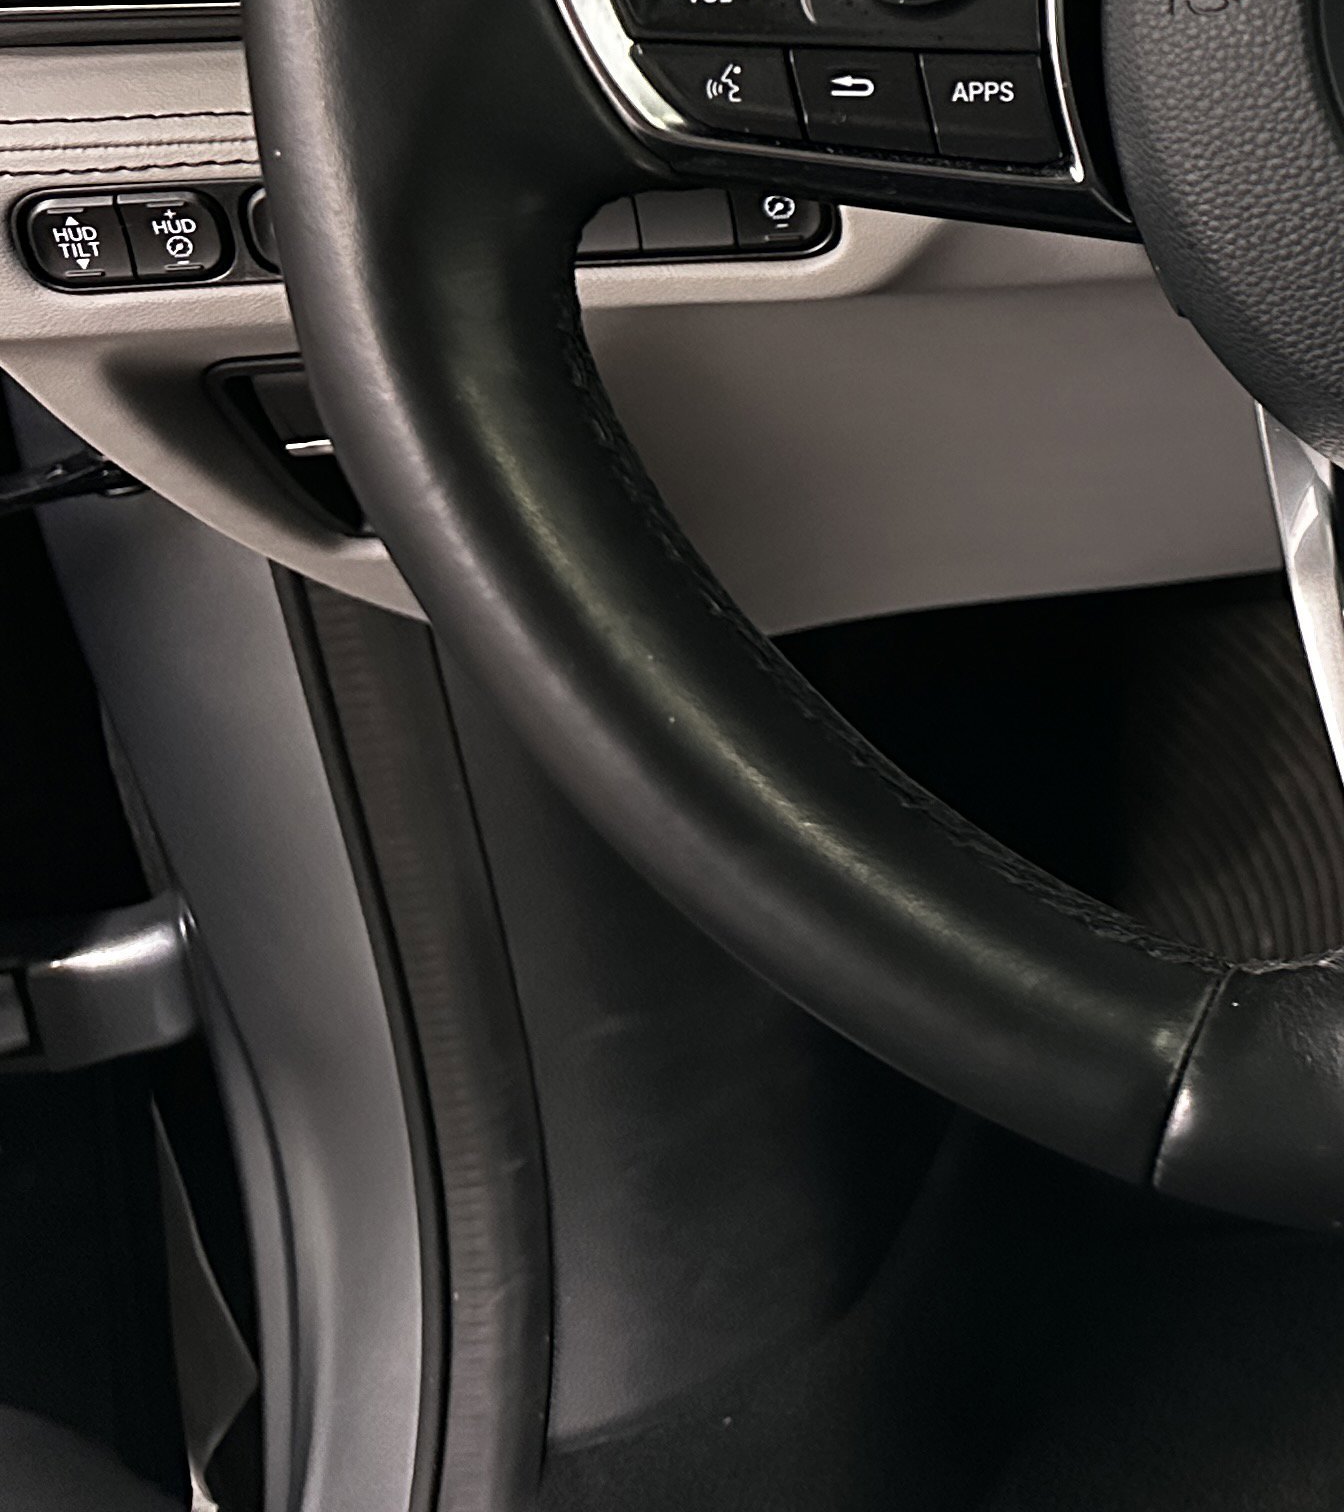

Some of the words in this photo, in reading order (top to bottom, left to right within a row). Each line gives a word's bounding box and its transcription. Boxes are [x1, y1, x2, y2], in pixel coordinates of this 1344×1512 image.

[951, 81, 1015, 102] APPS
[52, 226, 98, 243] HUD
[151, 218, 197, 236] HUD
[57, 241, 100, 259] TILT
